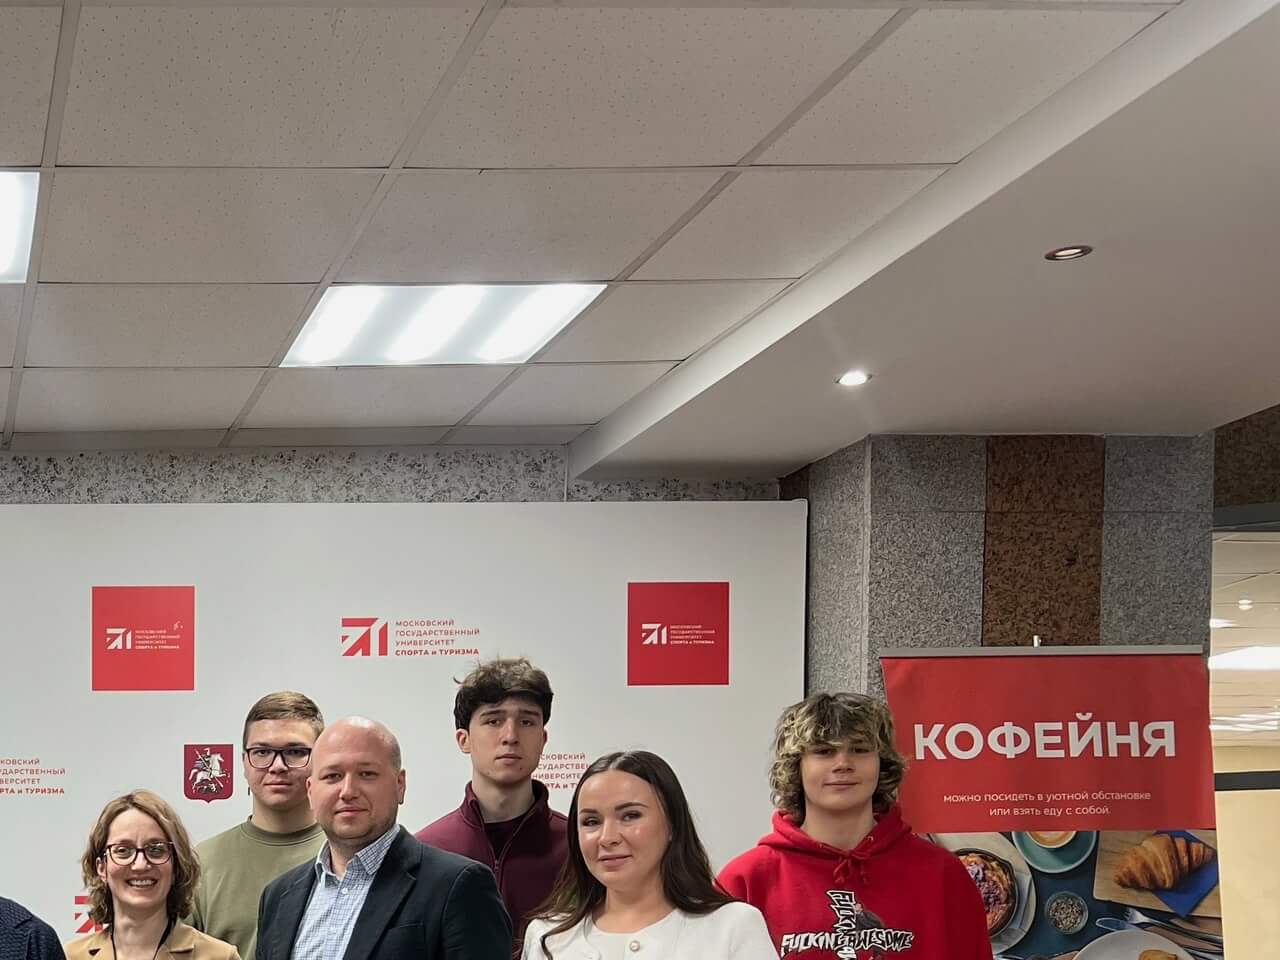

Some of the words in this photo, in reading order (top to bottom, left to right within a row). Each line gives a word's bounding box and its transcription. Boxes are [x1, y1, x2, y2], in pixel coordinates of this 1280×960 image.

[396, 628, 480, 637] ГОСУДАРСТВЕННЫЙ
[913, 712, 1176, 760] КОФЕЙНЯ
[541, 752, 586, 760] СКОВСКИЙ
[944, 794, 981, 802] можно
[984, 792, 1035, 802] посидеть
[1046, 791, 1088, 803] уютной
[1092, 791, 1152, 800] обстановке
[989, 807, 1010, 816] или
[1014, 807, 1041, 816] взять
[1044, 807, 1062, 818] еду
